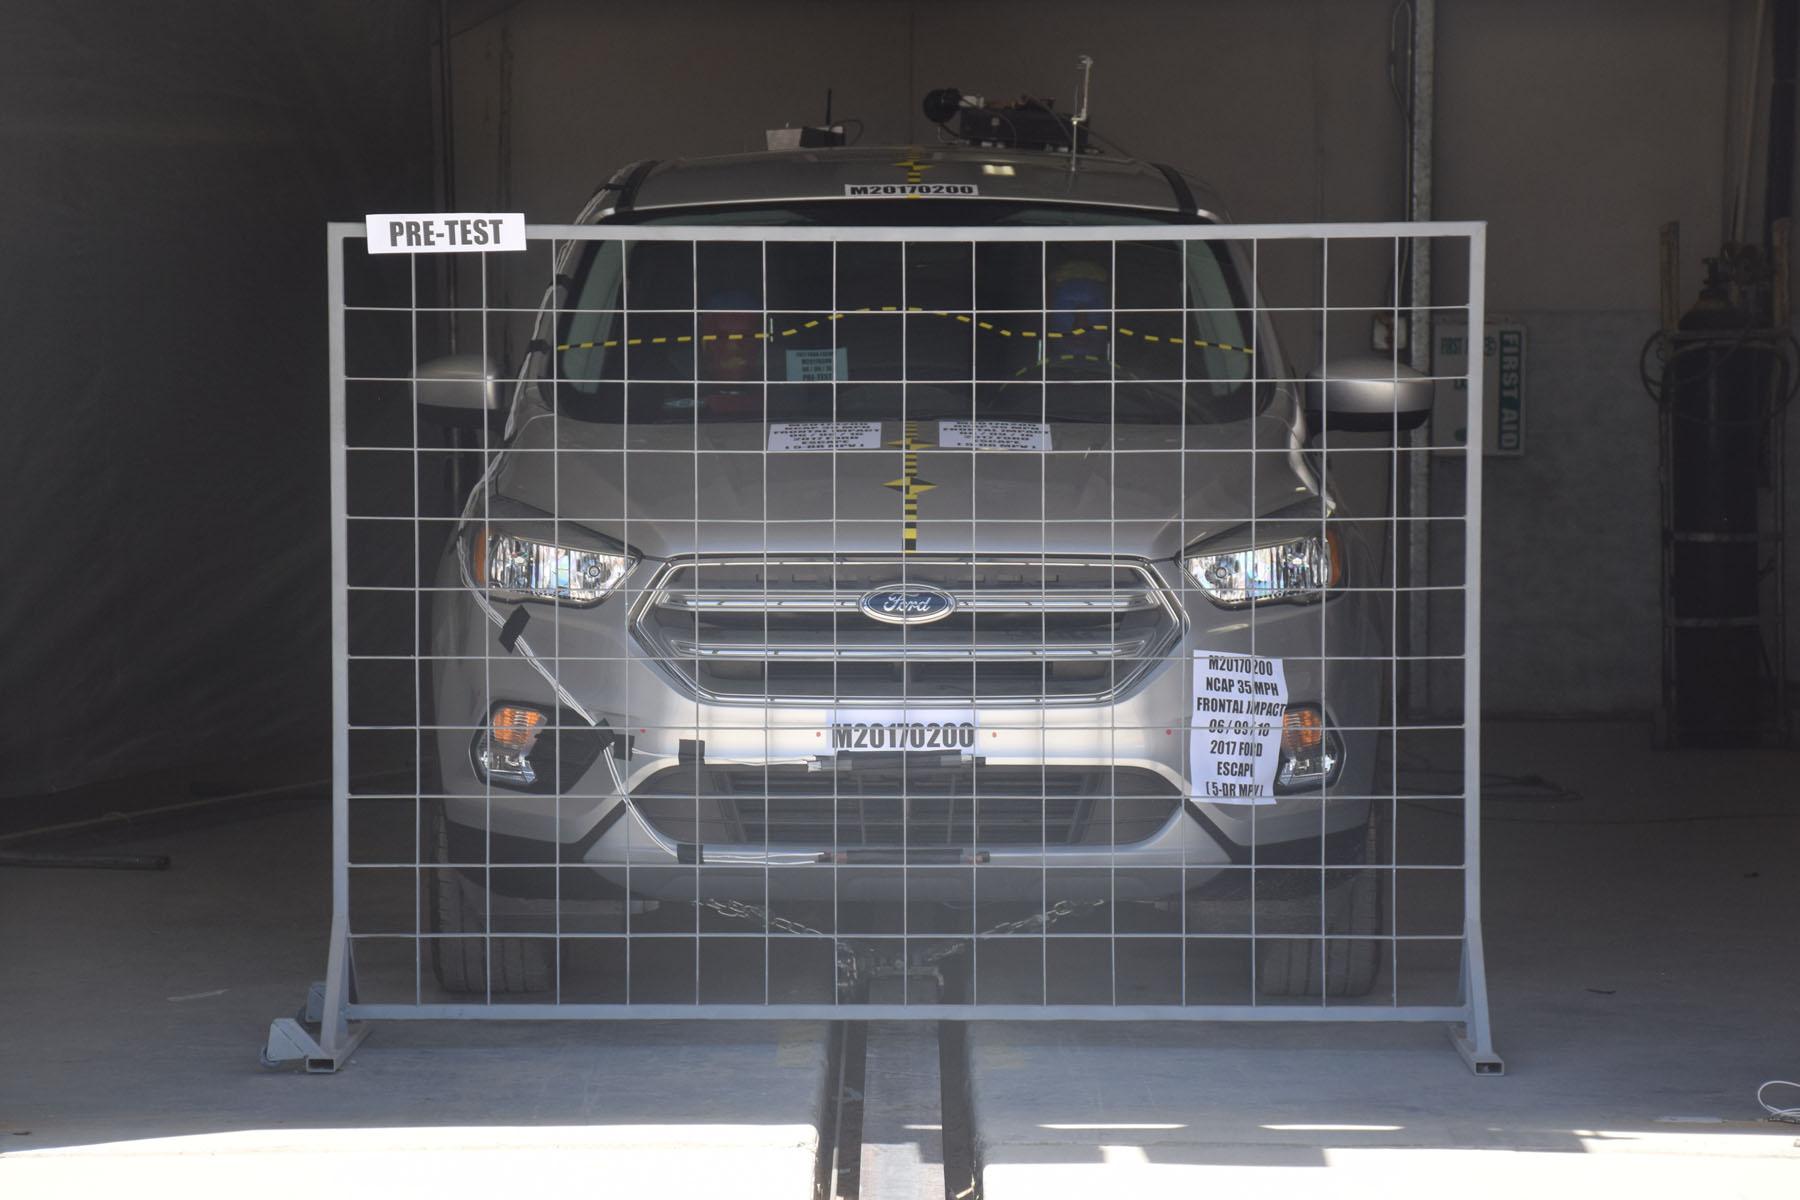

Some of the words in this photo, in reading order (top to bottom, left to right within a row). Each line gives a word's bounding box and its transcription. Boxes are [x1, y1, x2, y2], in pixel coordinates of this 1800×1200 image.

[389, 219, 503, 247] PRE-TEST
[1502, 333, 1520, 400] FIRST
[1501, 407, 1519, 448] AID
[883, 593, 932, 612] Ford
[1206, 677, 1234, 693] NCAP
[1237, 680, 1252, 694] 35
[1254, 681, 1279, 696] MPH
[1197, 697, 1244, 714] FRONTAL
[1246, 701, 1287, 717] IMPACT
[832, 722, 974, 748] M20170200
[1210, 740, 1236, 755] 2017
